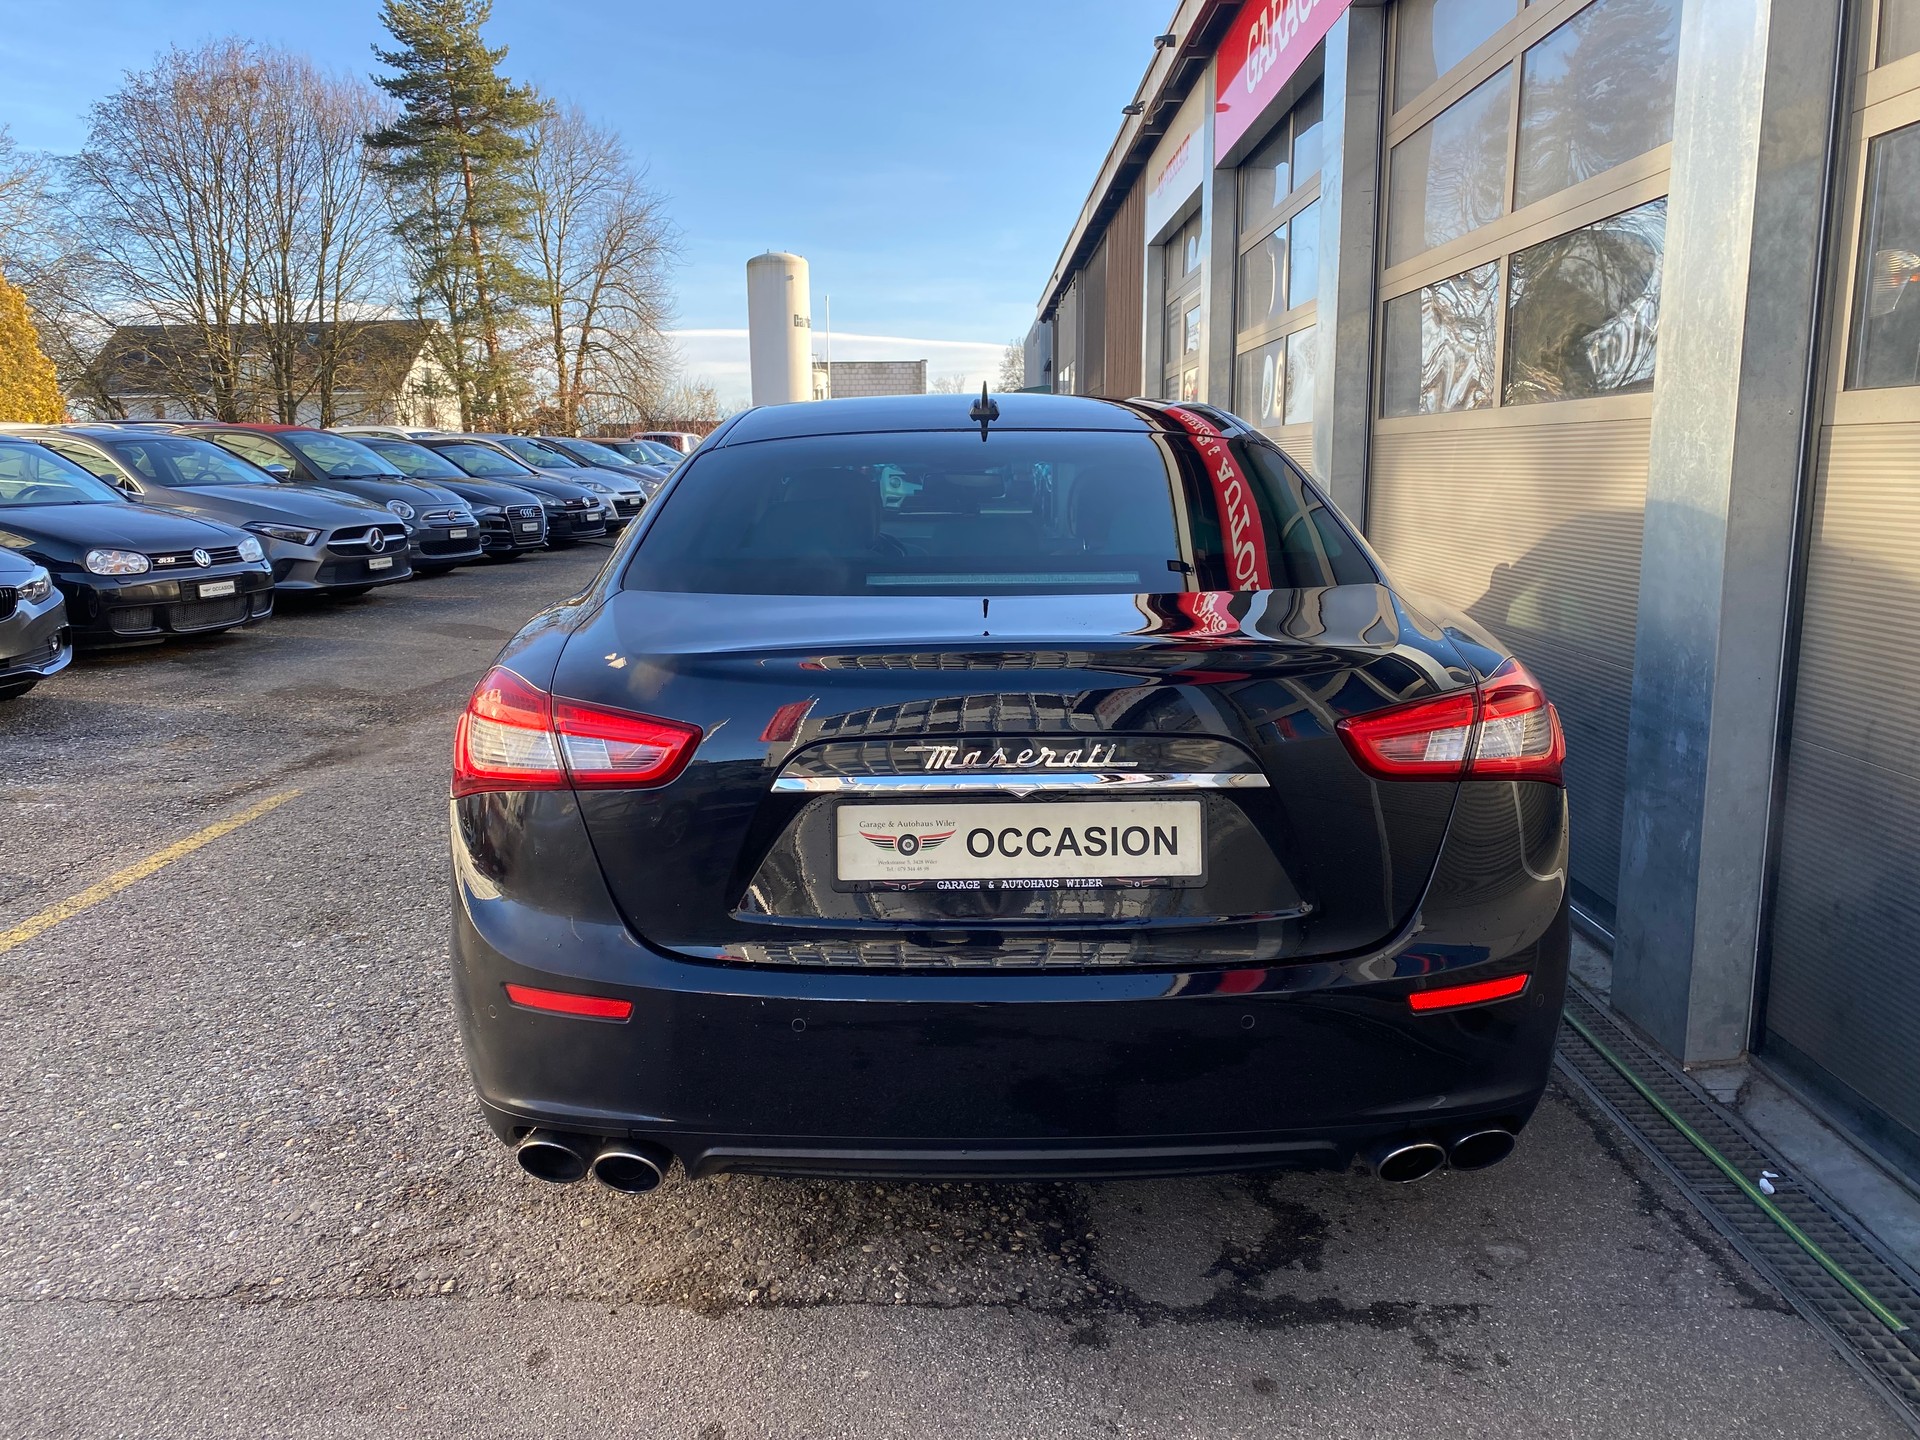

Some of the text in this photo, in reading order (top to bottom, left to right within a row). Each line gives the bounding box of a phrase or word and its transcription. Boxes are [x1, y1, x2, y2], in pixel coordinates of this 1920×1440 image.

[1246, 0, 1321, 94] GARA
[904, 743, 1139, 770] Maserati
[859, 819, 956, 829] Garage & Autohaus Wiler
[966, 825, 1178, 858] OCCASION
[937, 878, 1104, 890] GARAGE & AUTOHAUS WILER
